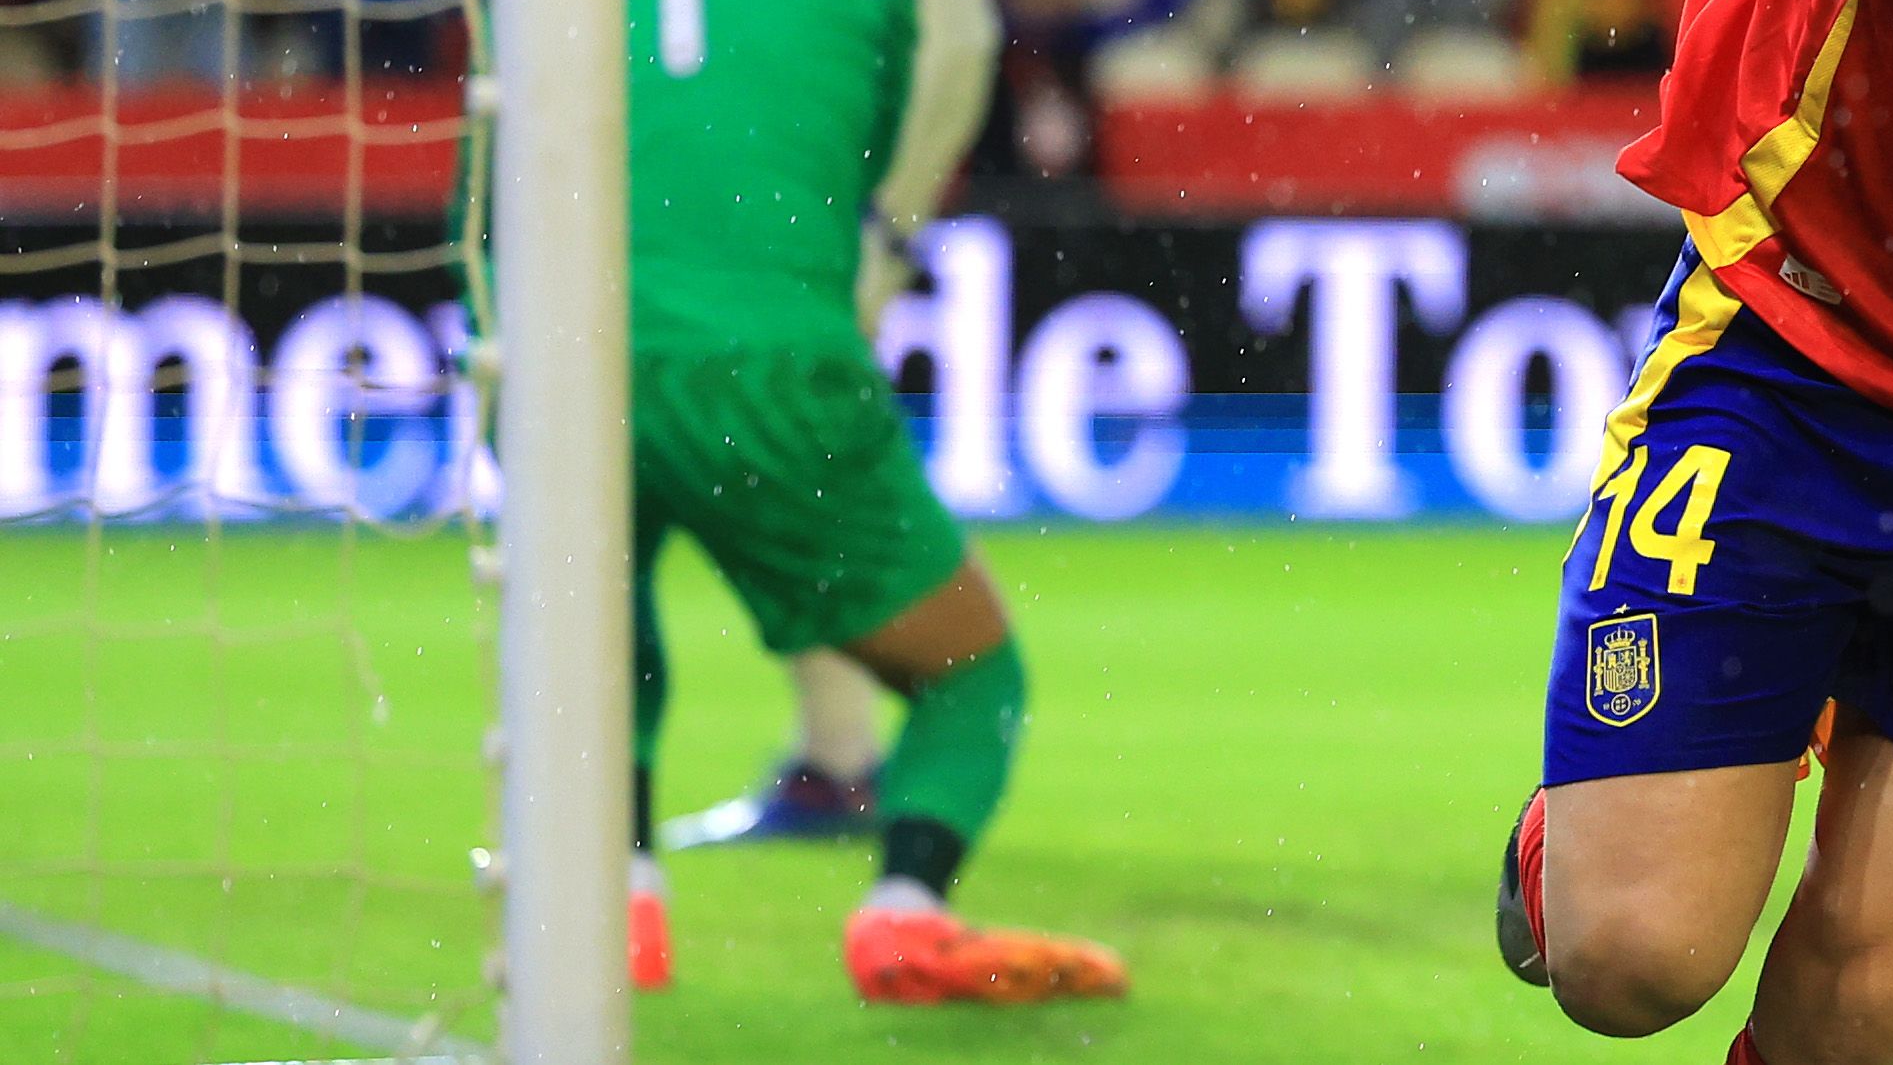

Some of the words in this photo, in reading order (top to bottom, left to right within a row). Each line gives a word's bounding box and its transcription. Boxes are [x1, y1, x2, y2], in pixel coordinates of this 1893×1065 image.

[875, 213, 1195, 521] de
[1240, 216, 1655, 525] To
[1588, 444, 1732, 596] 14
